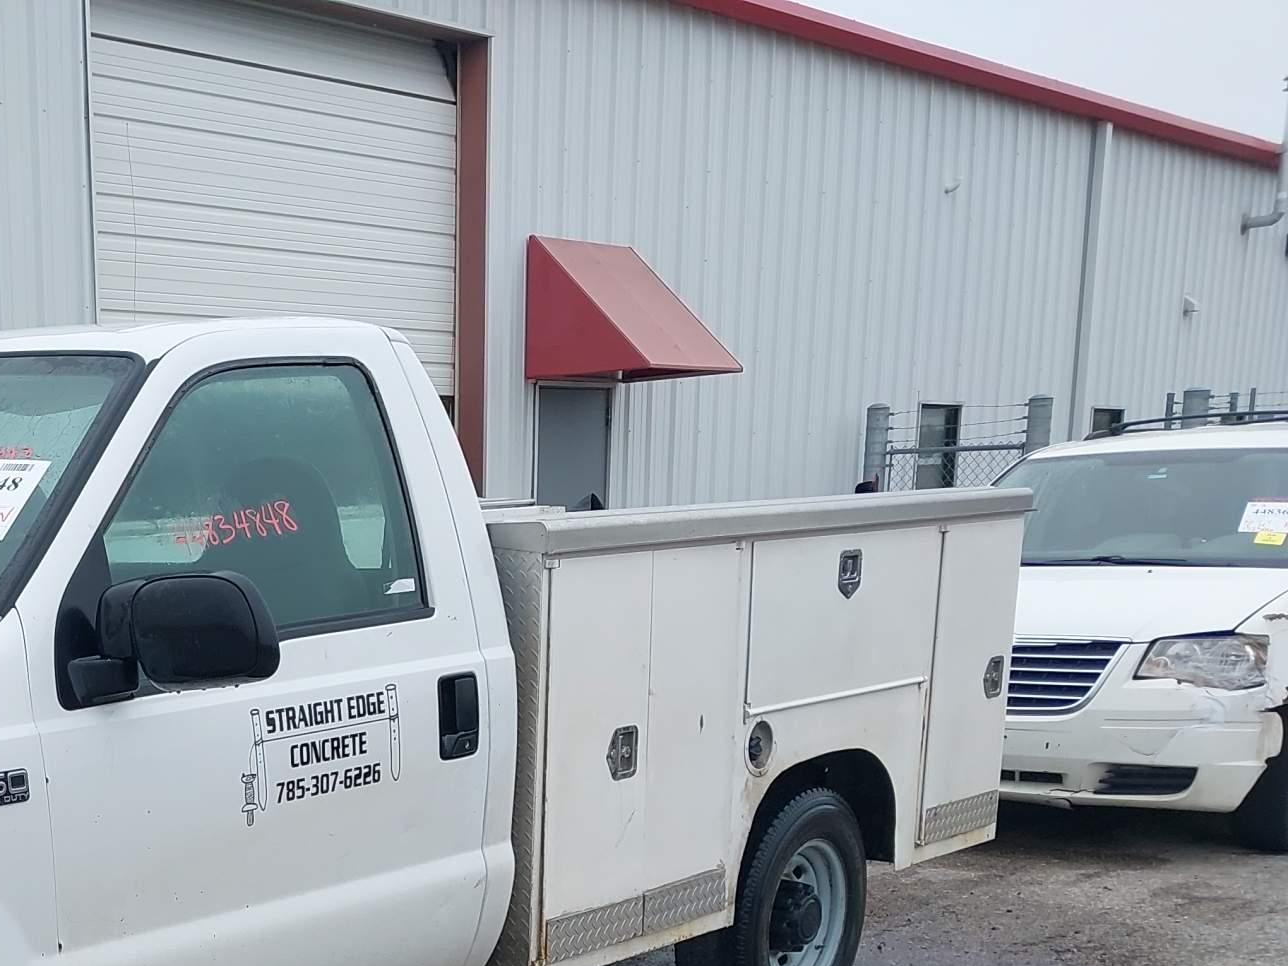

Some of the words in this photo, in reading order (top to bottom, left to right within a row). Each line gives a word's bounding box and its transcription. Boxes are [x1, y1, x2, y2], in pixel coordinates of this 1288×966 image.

[265, 698, 343, 733] STRAIGHT
[347, 691, 385, 719] EDGE
[290, 732, 367, 768] CONCRETE
[3, 791, 29, 803] DUTY
[276, 763, 381, 803] 785-307-6226
